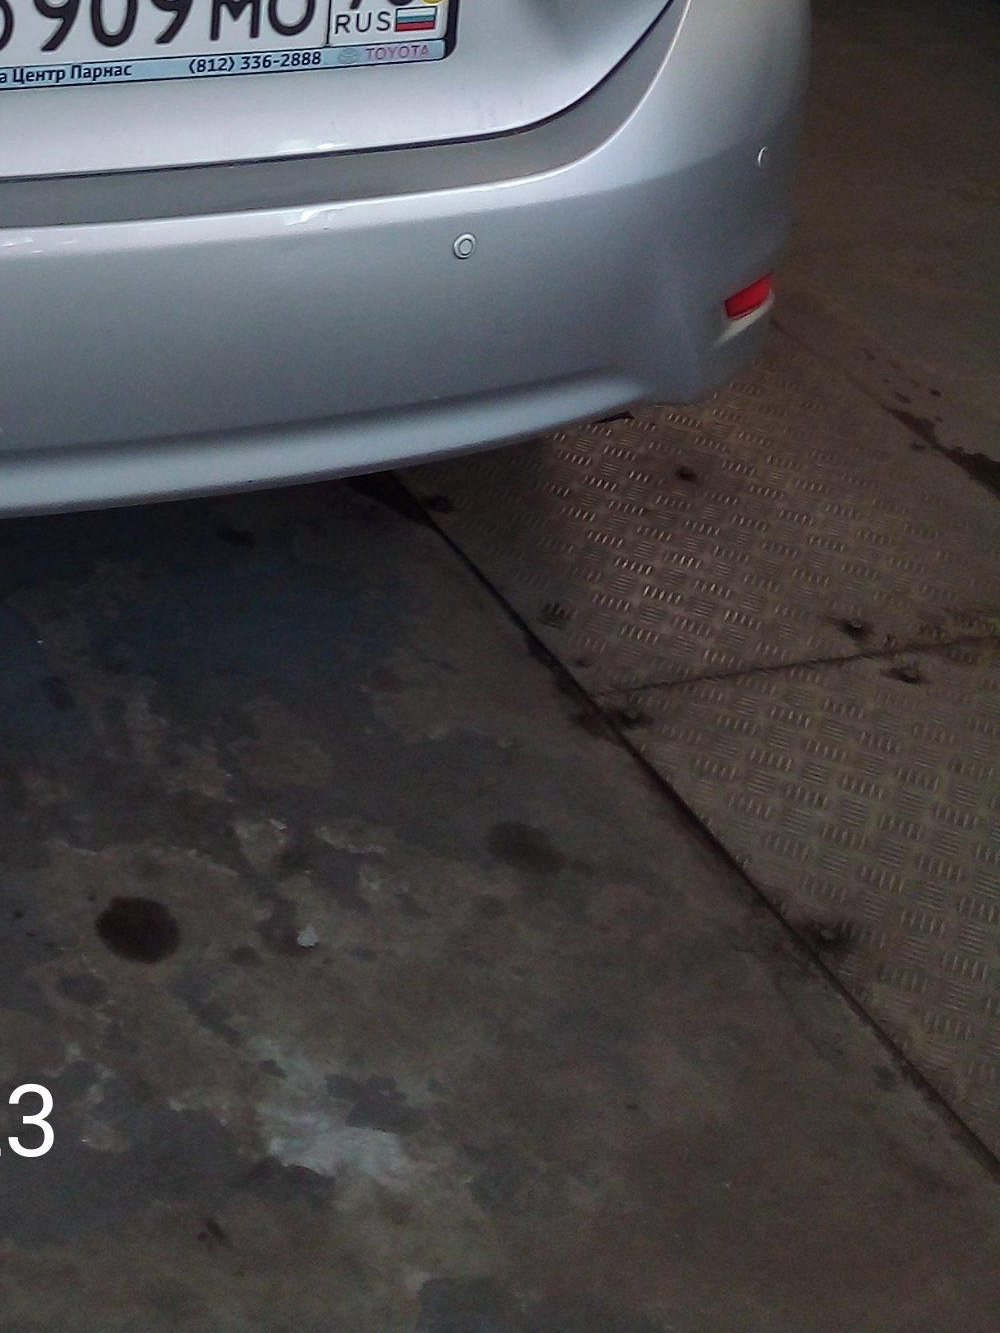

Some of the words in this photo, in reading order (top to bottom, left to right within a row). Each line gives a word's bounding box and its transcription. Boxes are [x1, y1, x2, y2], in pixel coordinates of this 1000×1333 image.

[334, 11, 391, 35] RUS
[366, 44, 430, 61] TOYOTA
[12, 67, 66, 84] Центр
[70, 64, 132, 82] Парнас
[188, 56, 235, 74] (812)
[240, 51, 322, 70] 336-2888
